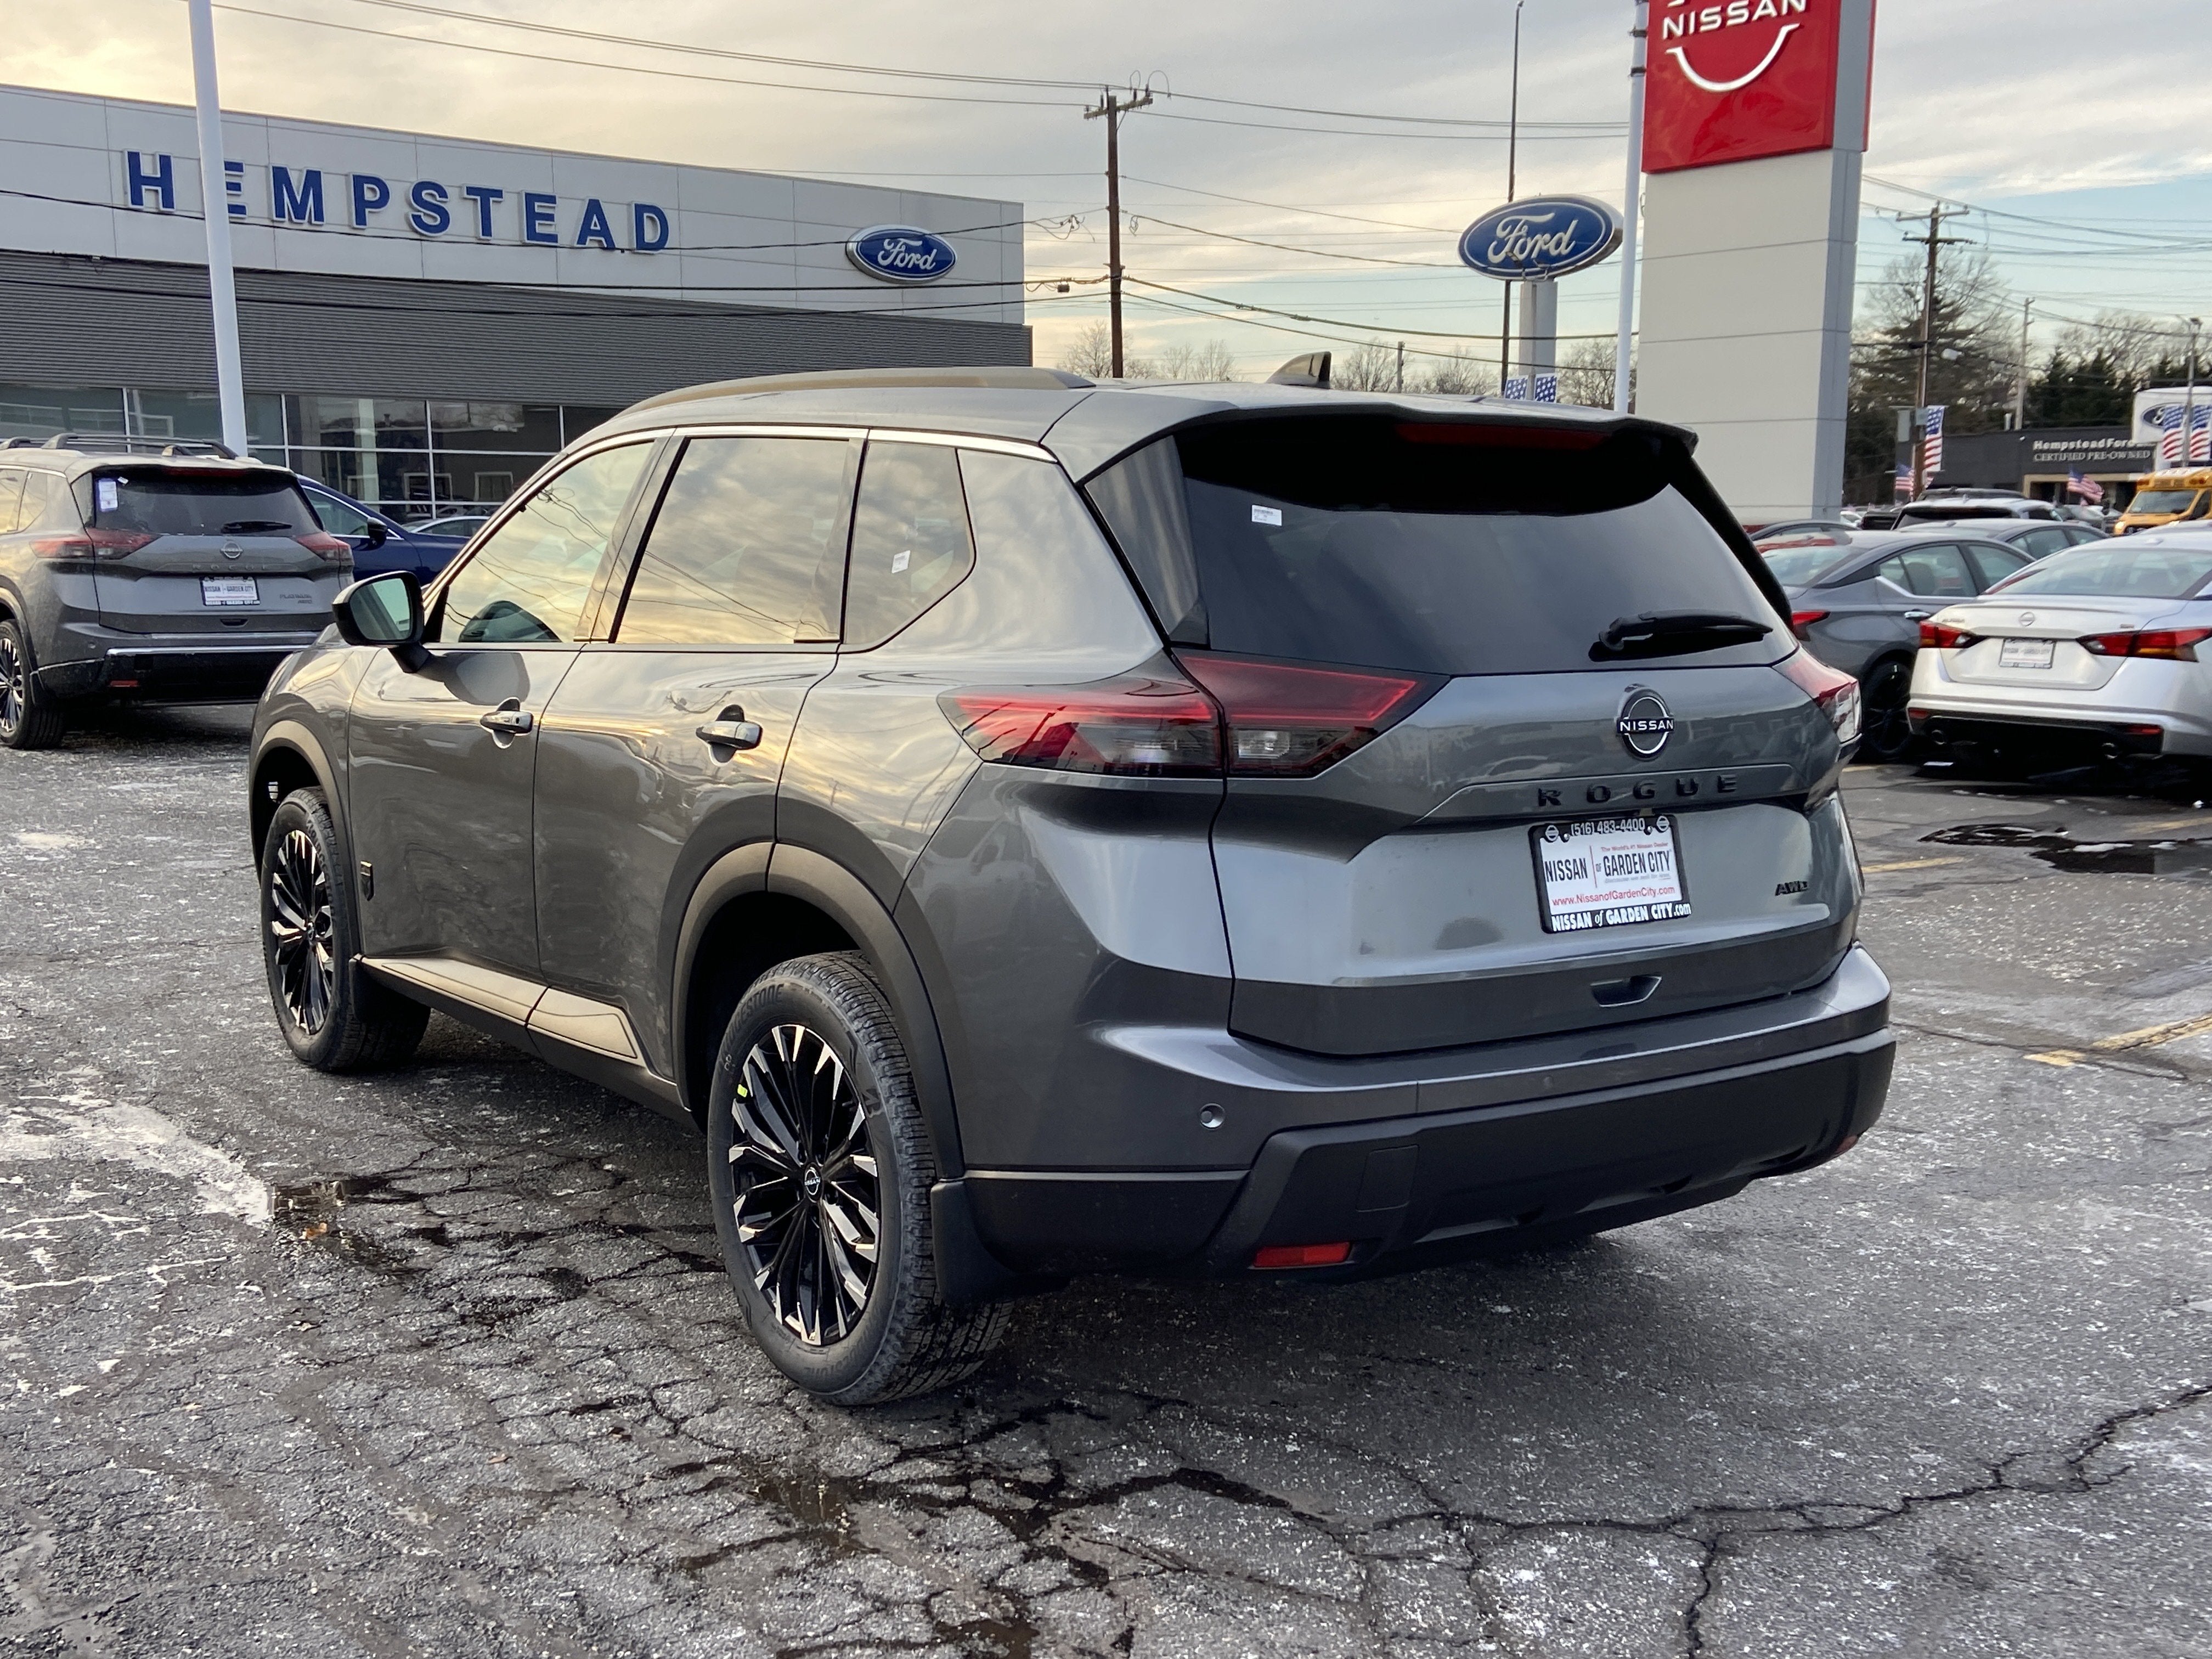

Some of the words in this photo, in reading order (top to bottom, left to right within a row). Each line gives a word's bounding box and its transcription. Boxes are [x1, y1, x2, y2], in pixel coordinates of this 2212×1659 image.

[1662, 0, 1806, 40] NISSAN
[127, 151, 670, 252] HEMPSTEAD
[1487, 212, 1579, 264] Ford
[877, 238, 937, 270] Ford
[2033, 452, 2086, 462] CERTIFIED
[2087, 450, 2152, 461] PRE-OWNED
[1620, 720, 1674, 731] NISSAN
[1538, 774, 1737, 807] ROGUE
[1571, 821, 1594, 836] (516)
[1597, 818, 1645, 834] 483-4400
[1544, 857, 1588, 882] NISSAN
[1603, 852, 1647, 877] GARDEN
[1552, 886, 1675, 906] www.NissanofGardenCity.com
[1775, 881, 1809, 896] AWD
[1551, 912, 1593, 932] NISSAN
[1594, 910, 1604, 927] of
[1606, 906, 1649, 925] GARDEN
